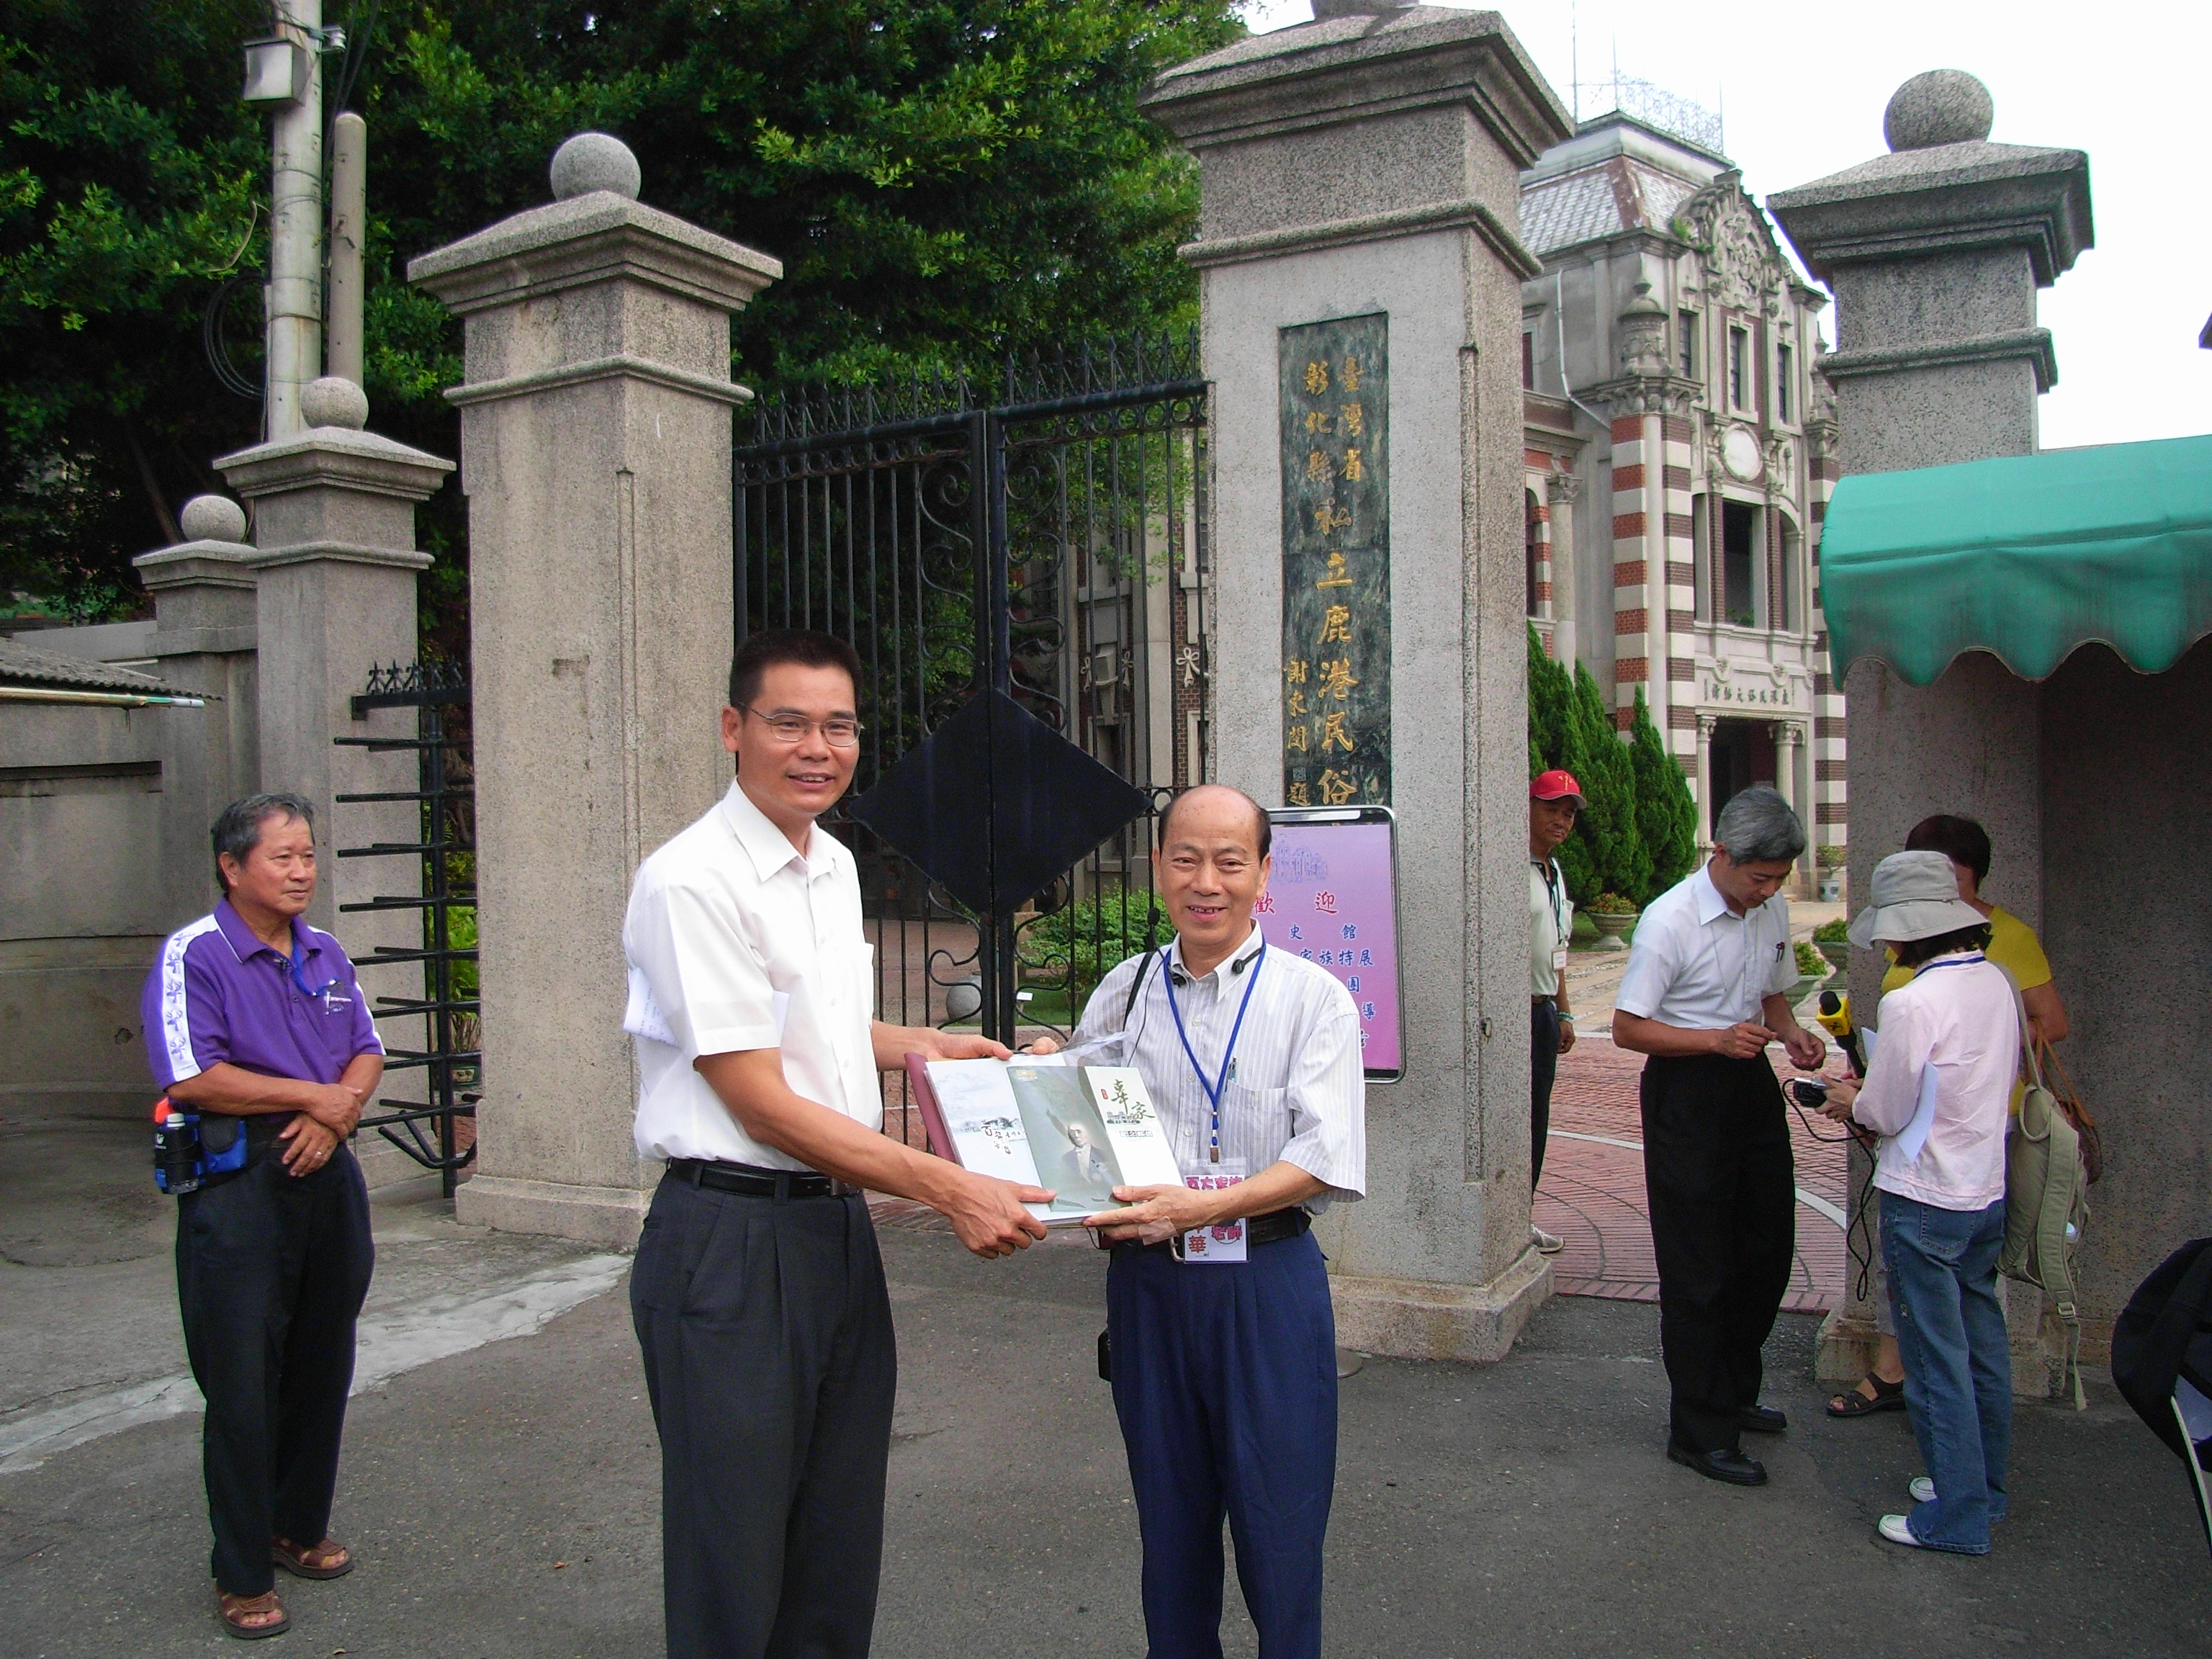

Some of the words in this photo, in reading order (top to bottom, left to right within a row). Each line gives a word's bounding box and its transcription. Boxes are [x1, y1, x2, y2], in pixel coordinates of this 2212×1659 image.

[1303, 360, 1335, 483] 彰化縣
[1314, 497, 1359, 806] 私立鹿港民俗
